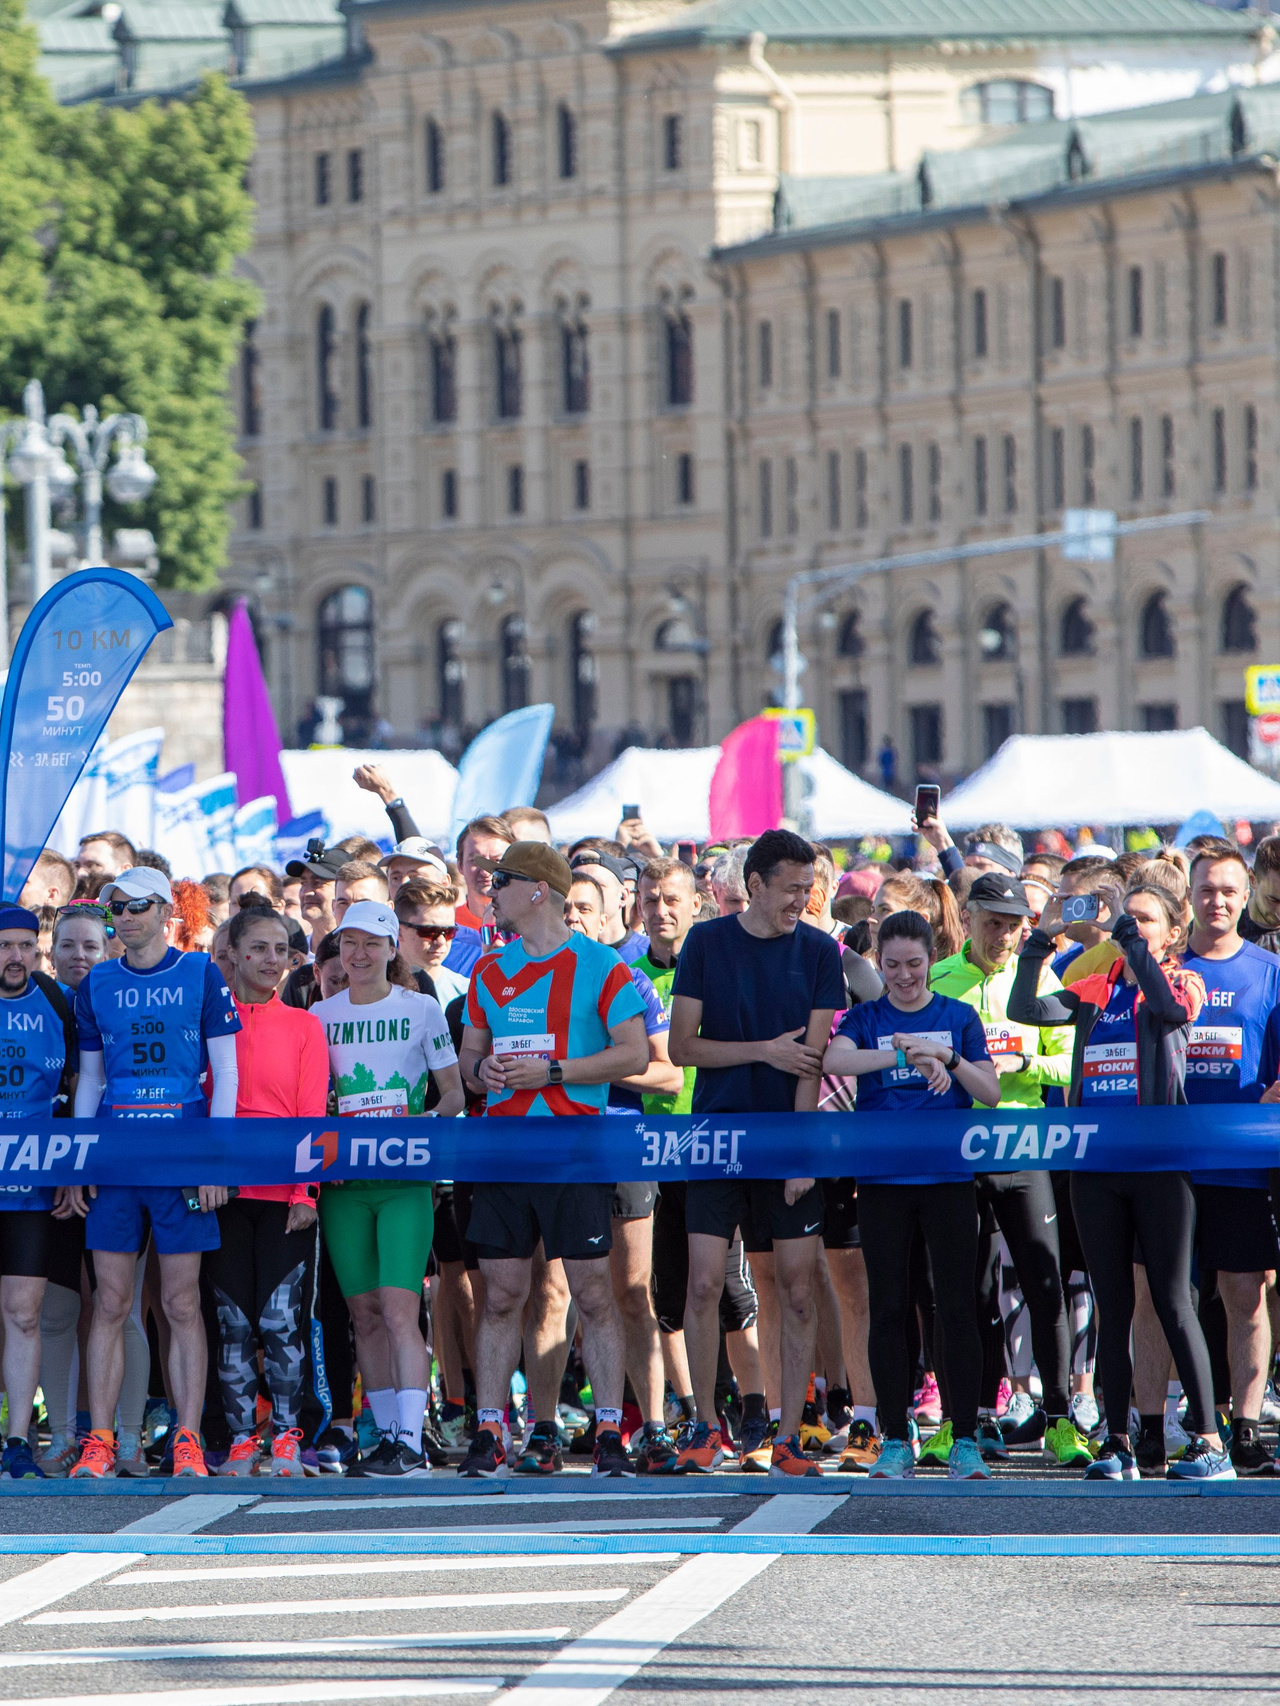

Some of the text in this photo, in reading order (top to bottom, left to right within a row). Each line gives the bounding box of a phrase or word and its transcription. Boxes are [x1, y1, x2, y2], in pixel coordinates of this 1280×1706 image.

[53, 630, 82, 650] 10
[62, 671, 102, 687] 5:00
[46, 695, 85, 722] 50
[42, 725, 84, 736] МИНУТ
[114, 988, 139, 1008] 10
[131, 1021, 164, 1035] 5:00
[133, 1042, 165, 1064] 50
[132, 1068, 167, 1077] МИНУТ
[1091, 1079, 1138, 1092] 14124
[349, 1137, 431, 1167] ПСБ
[960, 1124, 1099, 1160] СТАРТ
